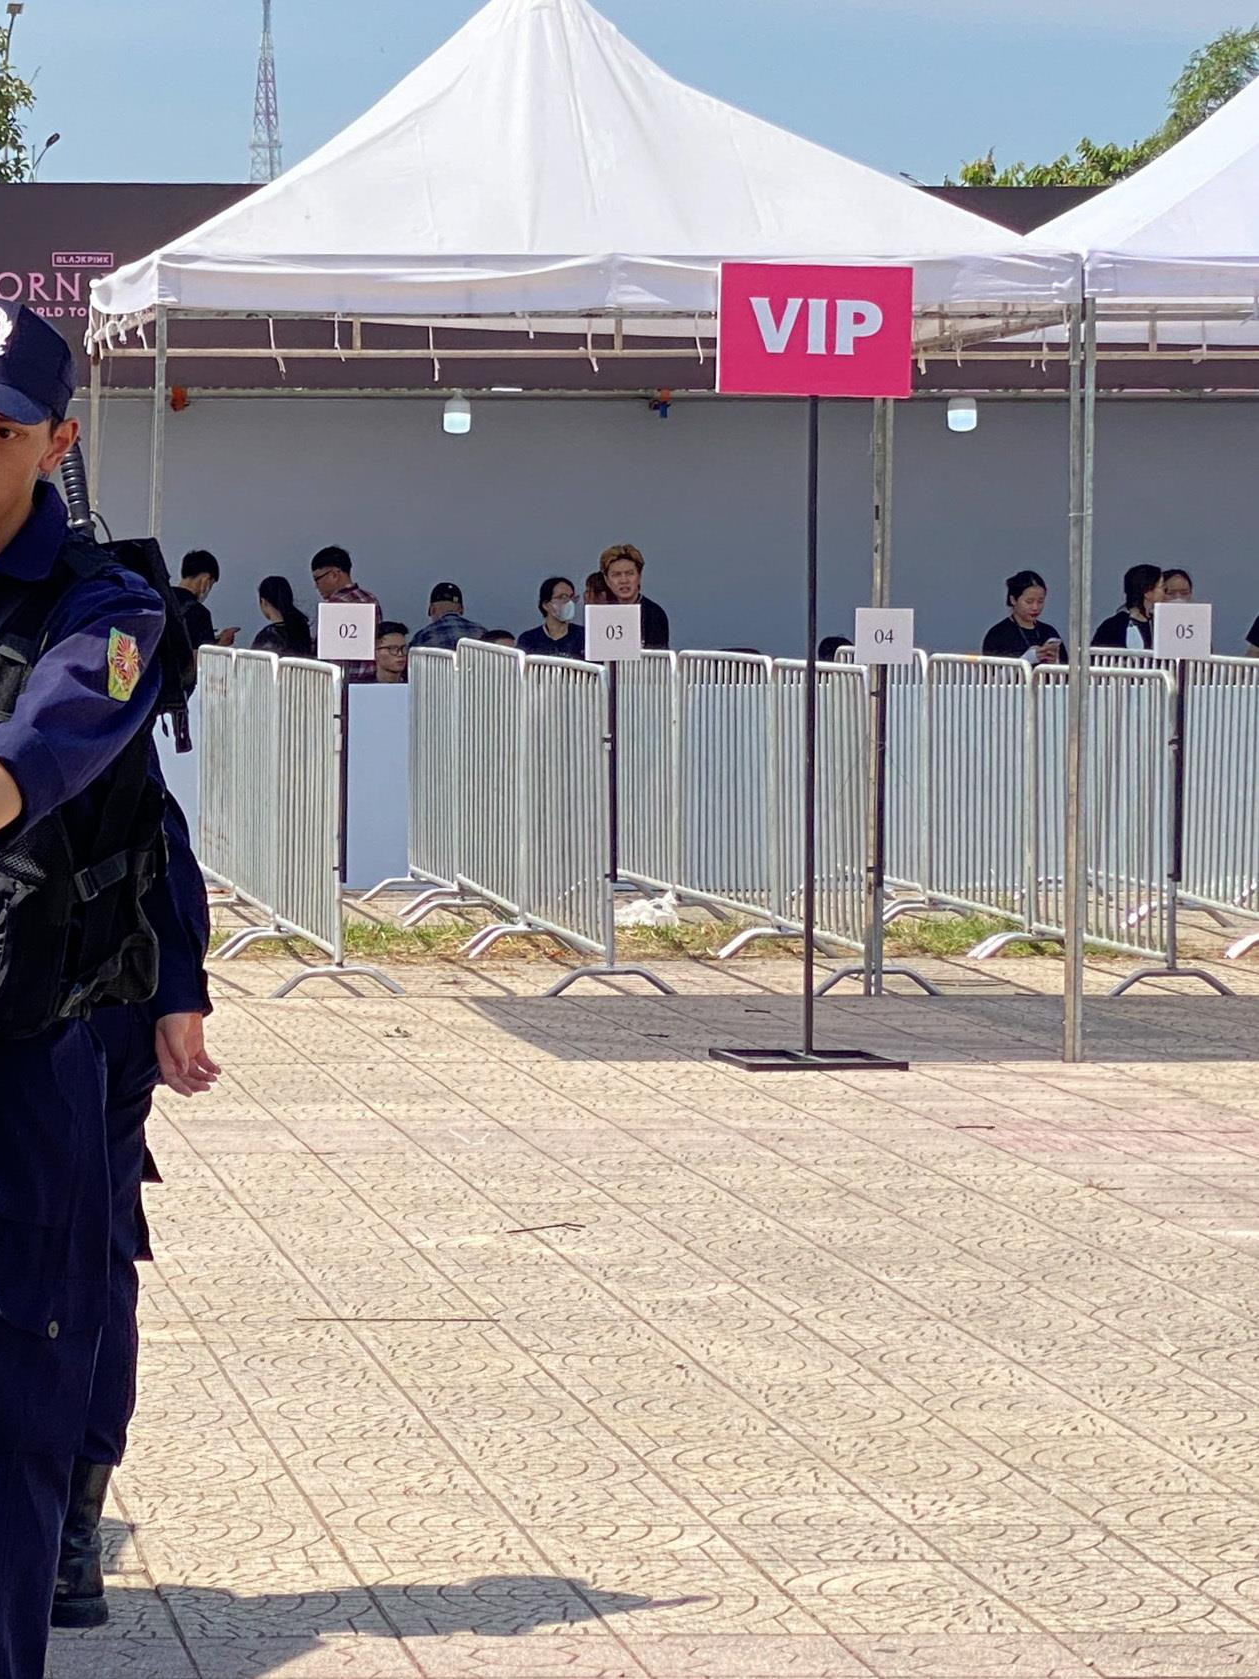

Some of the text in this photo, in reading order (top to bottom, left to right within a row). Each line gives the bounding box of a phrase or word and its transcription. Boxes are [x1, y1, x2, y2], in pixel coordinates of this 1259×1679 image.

[55, 255, 110, 264] BLACKPINK
[748, 296, 884, 356] VIP
[339, 623, 358, 639] 02
[606, 624, 623, 640] 03
[874, 628, 894, 644] 04
[1176, 623, 1194, 639] 05
